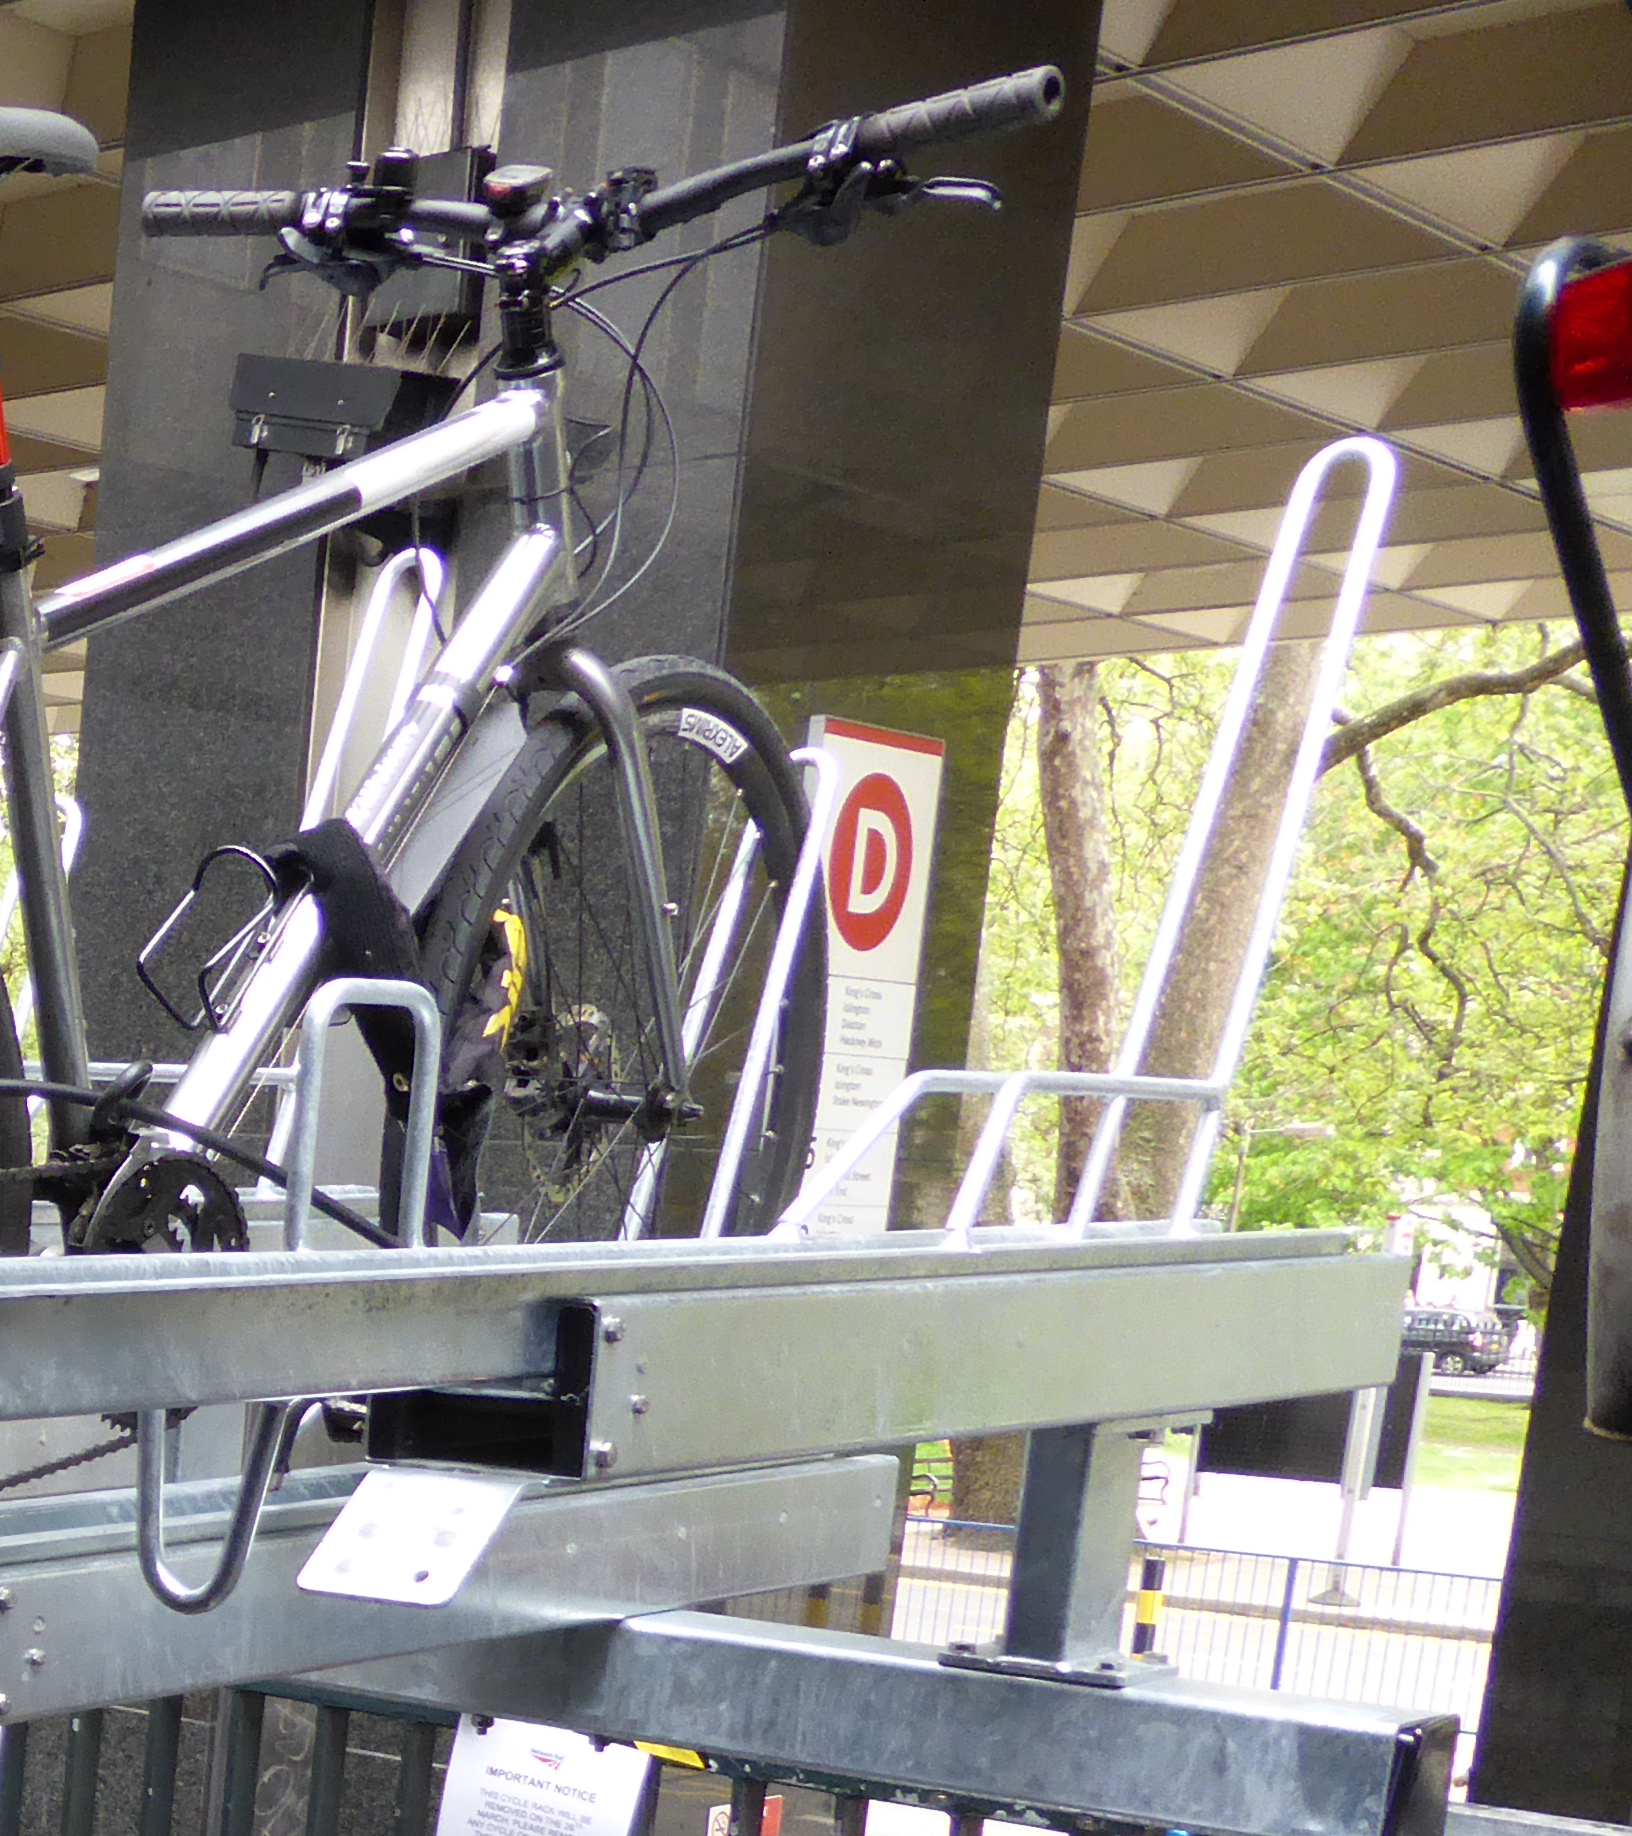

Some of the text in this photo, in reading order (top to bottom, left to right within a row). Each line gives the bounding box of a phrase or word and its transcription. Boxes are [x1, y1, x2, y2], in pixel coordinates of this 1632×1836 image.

[846, 808, 897, 915] D
[485, 1766, 597, 1803] IMPORTANT NOTICE
[484, 1801, 528, 1819] REMOVED
[500, 1793, 529, 1809] CYCLE
[531, 1801, 555, 1816] RACK
[512, 1818, 546, 1836] PLEASE
